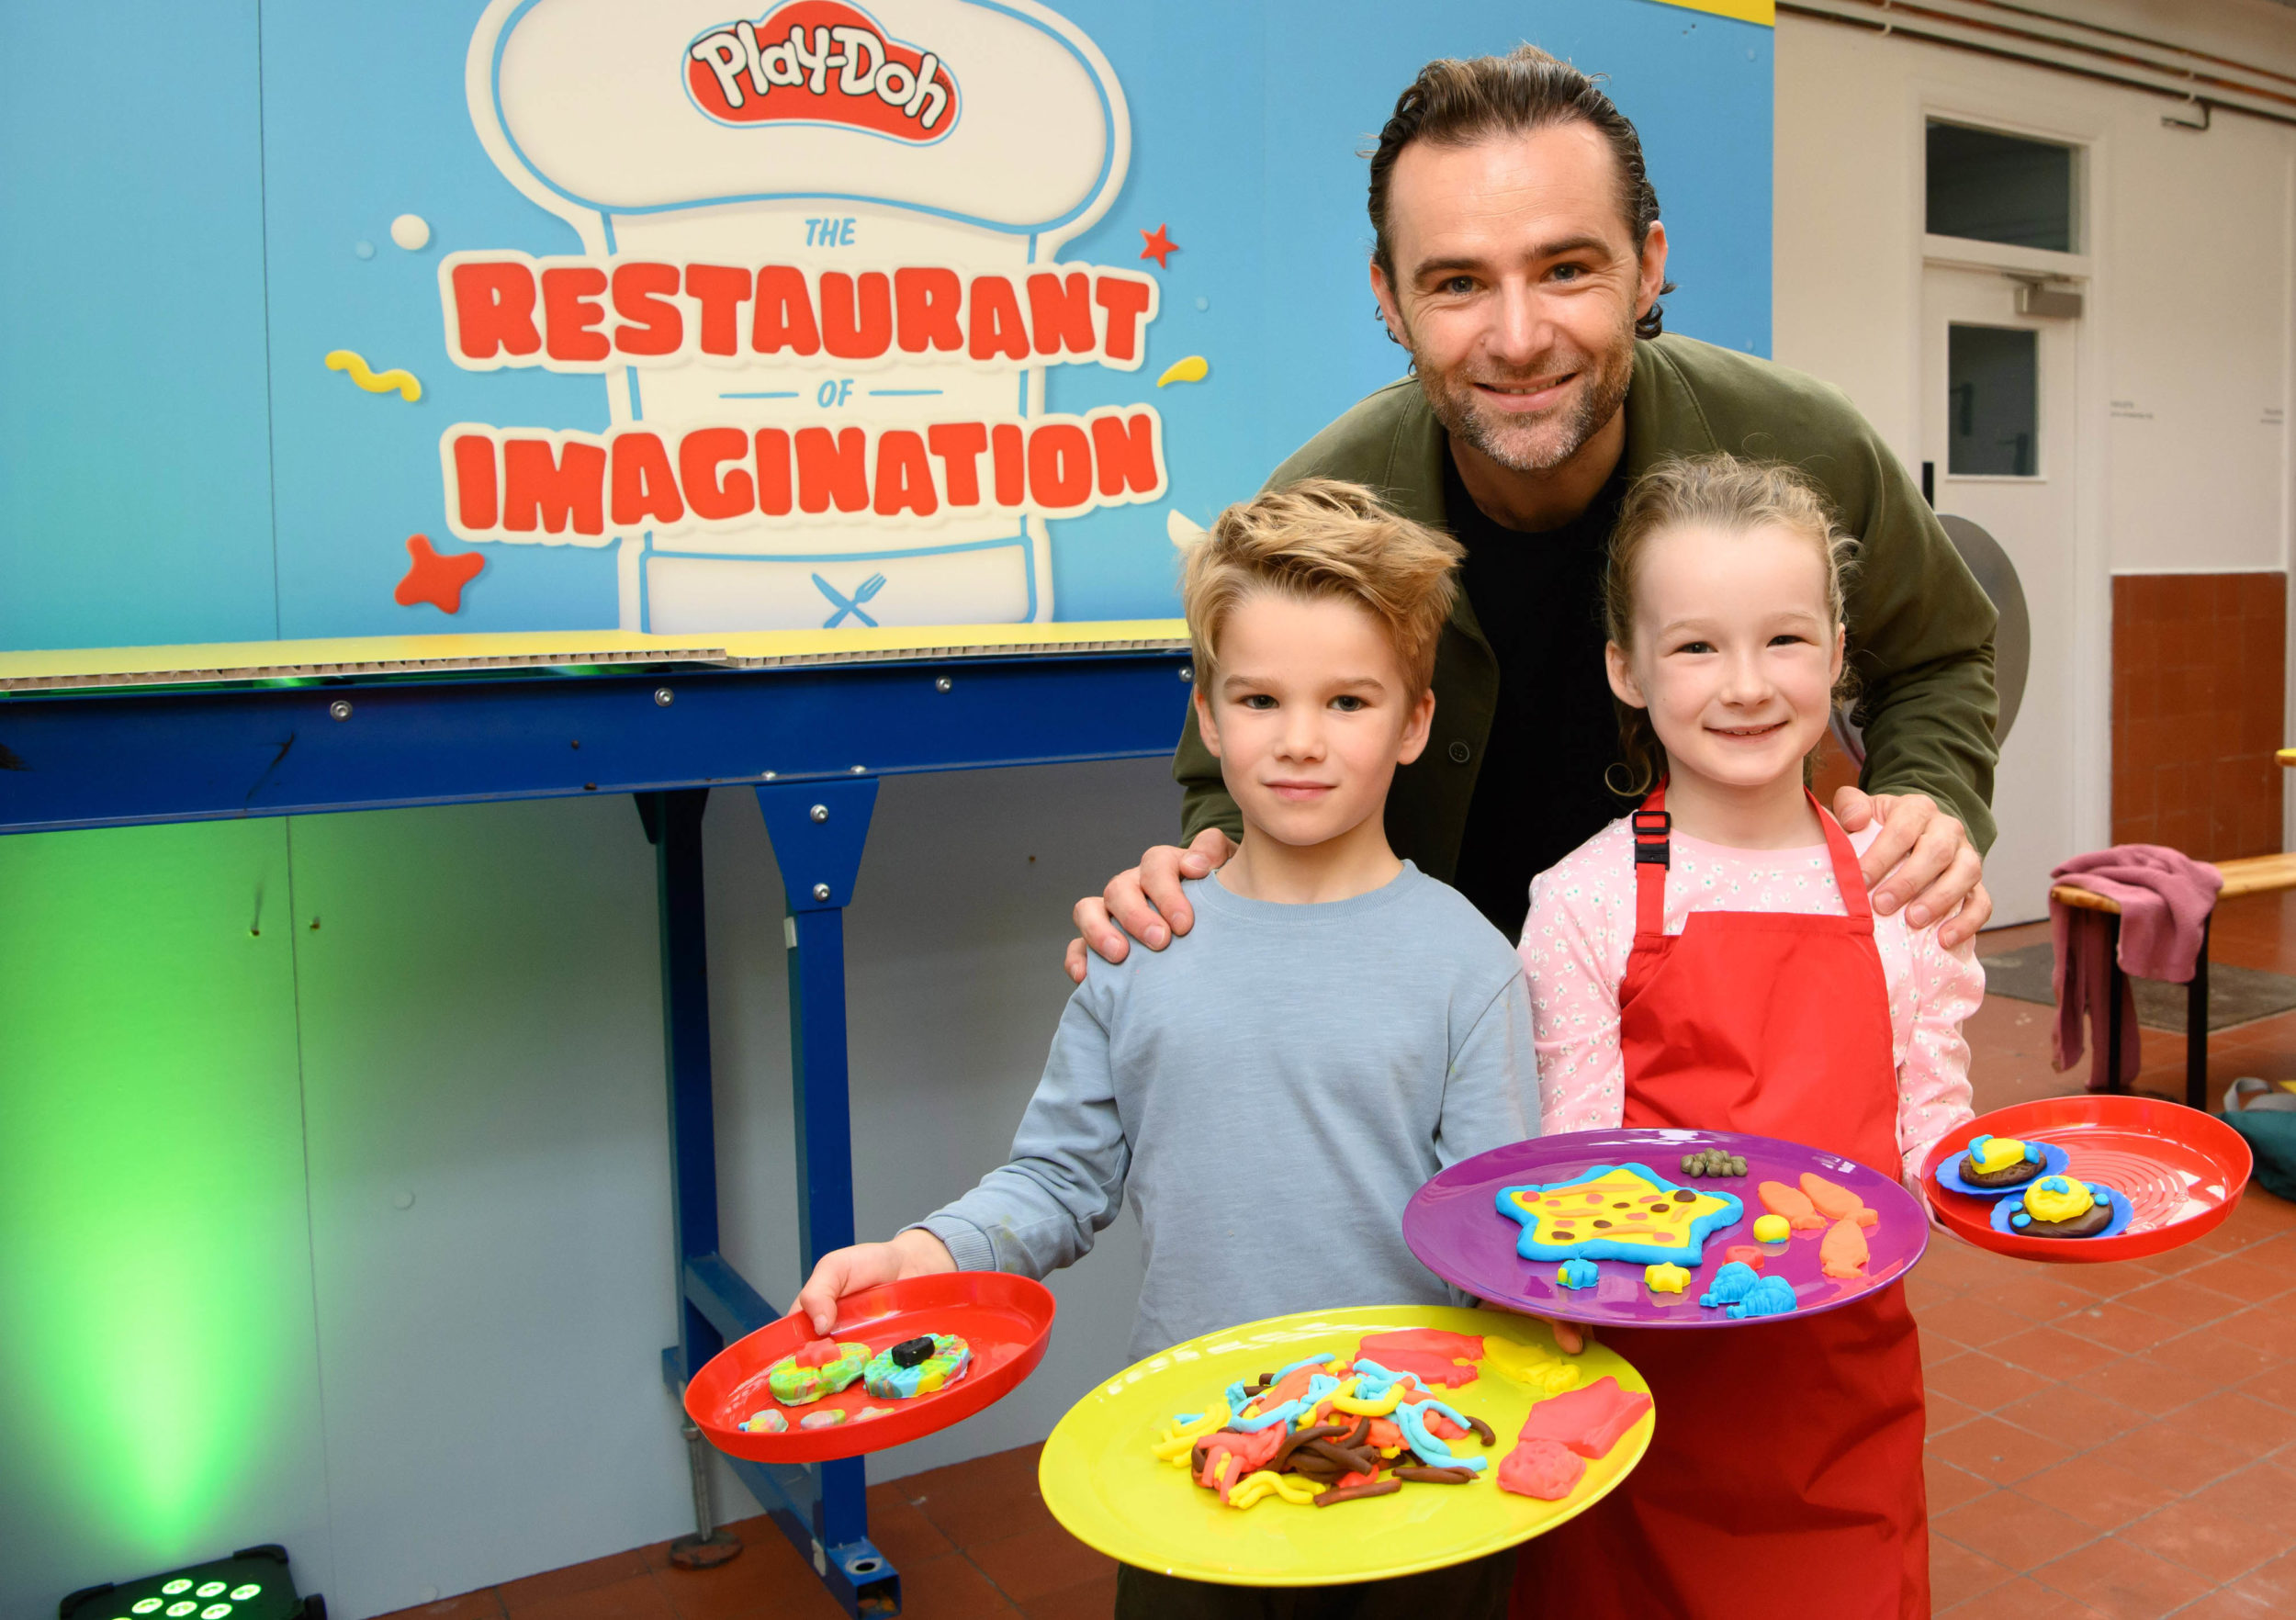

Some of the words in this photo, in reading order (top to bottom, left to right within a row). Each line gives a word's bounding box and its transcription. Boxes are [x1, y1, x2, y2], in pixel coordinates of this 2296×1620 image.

[690, 19, 948, 129] Play-Doh
[805, 219, 856, 248] THE
[452, 263, 1149, 362] RESTAURANT
[817, 380, 854, 409] OF
[454, 413, 1159, 536] IMAGINATION
